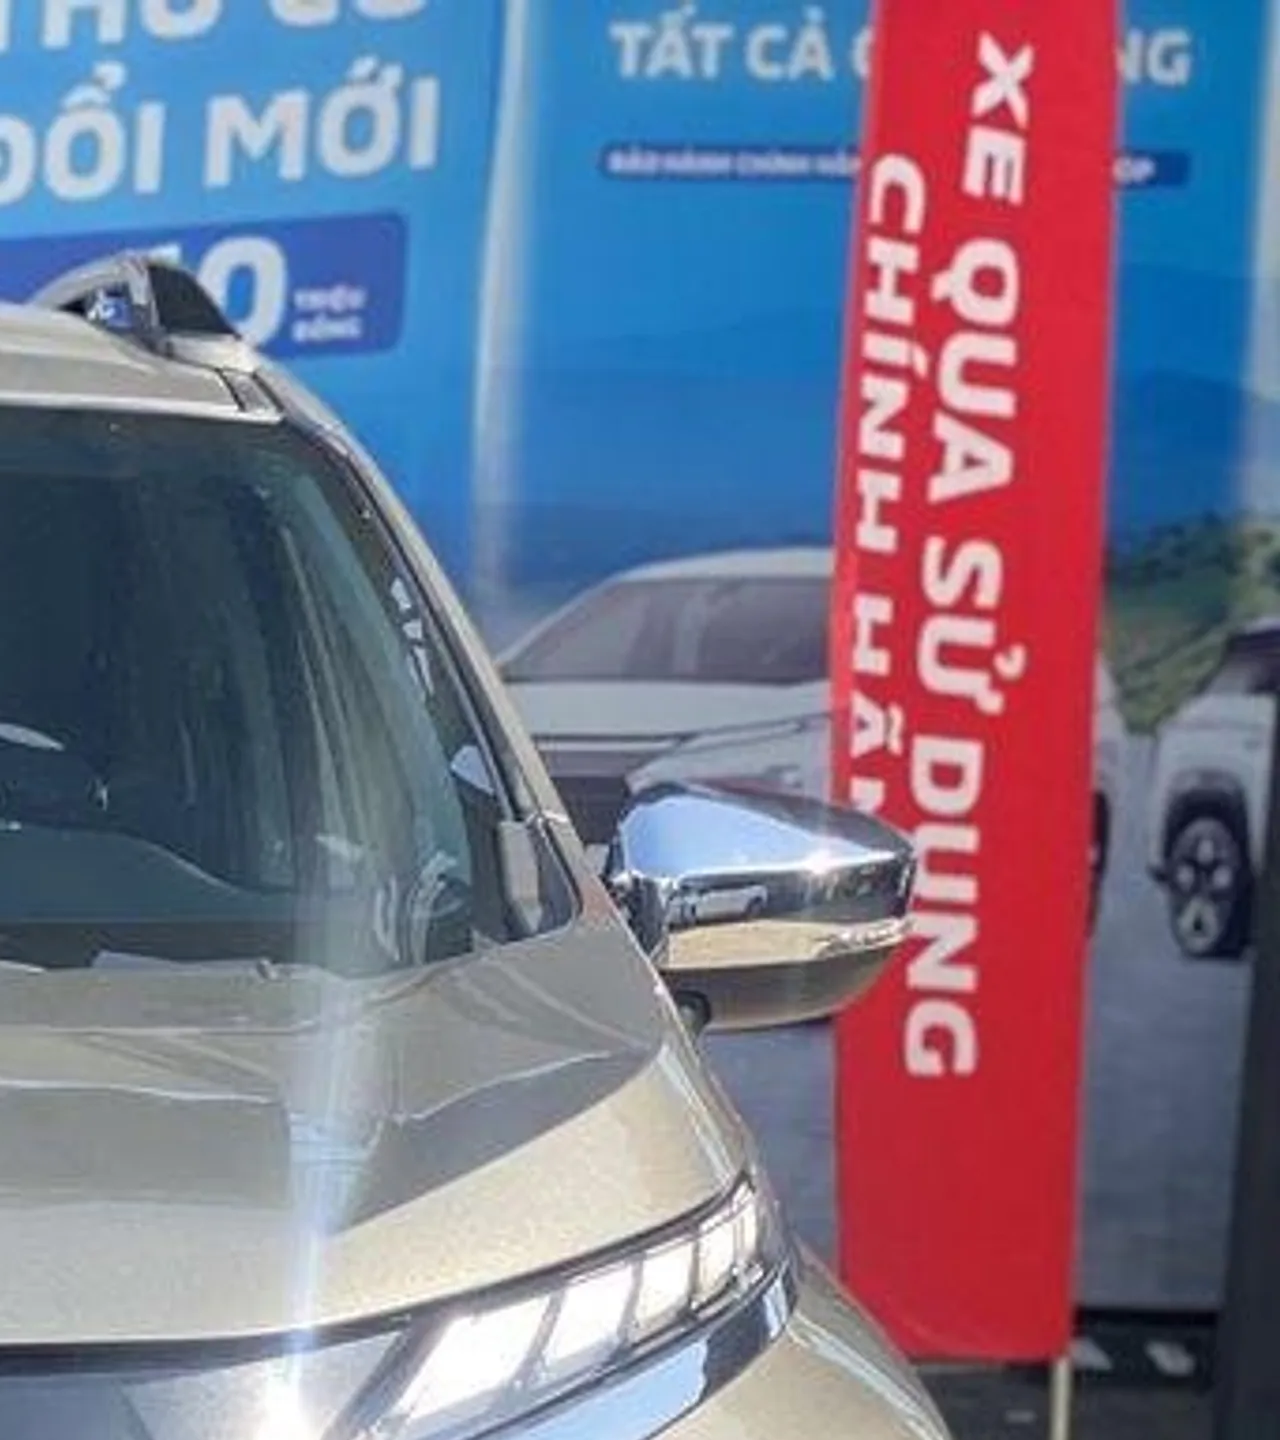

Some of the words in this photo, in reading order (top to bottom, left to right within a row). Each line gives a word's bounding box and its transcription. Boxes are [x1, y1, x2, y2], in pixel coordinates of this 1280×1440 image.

[202, 54, 439, 188] MỚI
[607, 6, 734, 80] TẤT
[745, 6, 836, 80] CẢ
[962, 29, 1035, 207] XE
[854, 151, 930, 553] CHÍNH
[928, 236, 1021, 504] QUA
[916, 536, 1028, 716] SỬ
